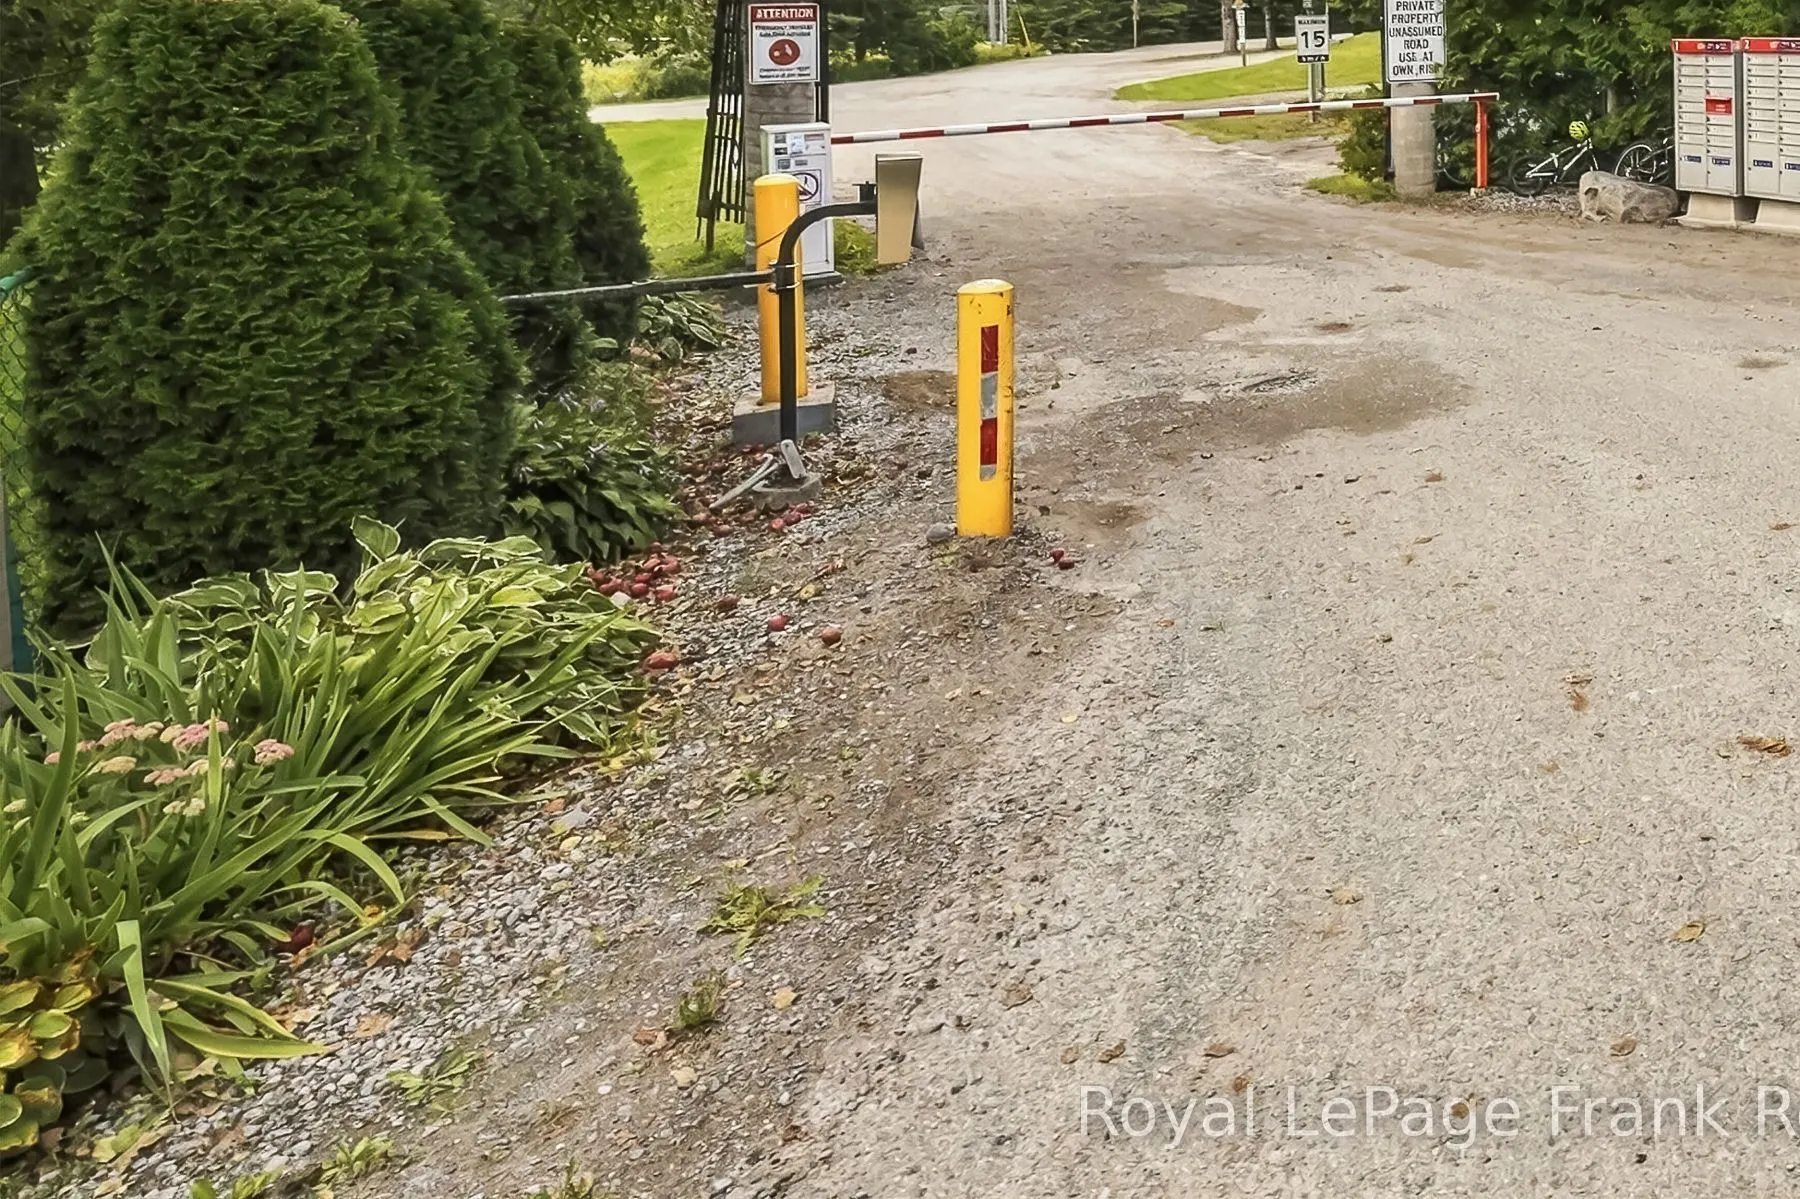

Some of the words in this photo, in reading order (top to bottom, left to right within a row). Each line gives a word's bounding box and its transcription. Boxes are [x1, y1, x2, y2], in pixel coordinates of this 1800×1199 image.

[1396, 0, 1435, 11] PRIVATE
[756, 8, 813, 19] ATTENTION
[1391, 13, 1439, 24] PROPERTY
[1389, 26, 1443, 38] UNASSUMED
[1301, 30, 1325, 49] 15
[1403, 39, 1429, 50] ROAD
[1744, 39, 1750, 50] 2
[1674, 41, 1679, 51] 1
[1399, 52, 1418, 63] USE
[1423, 52, 1433, 62] AT
[1393, 64, 1414, 77] OWN
